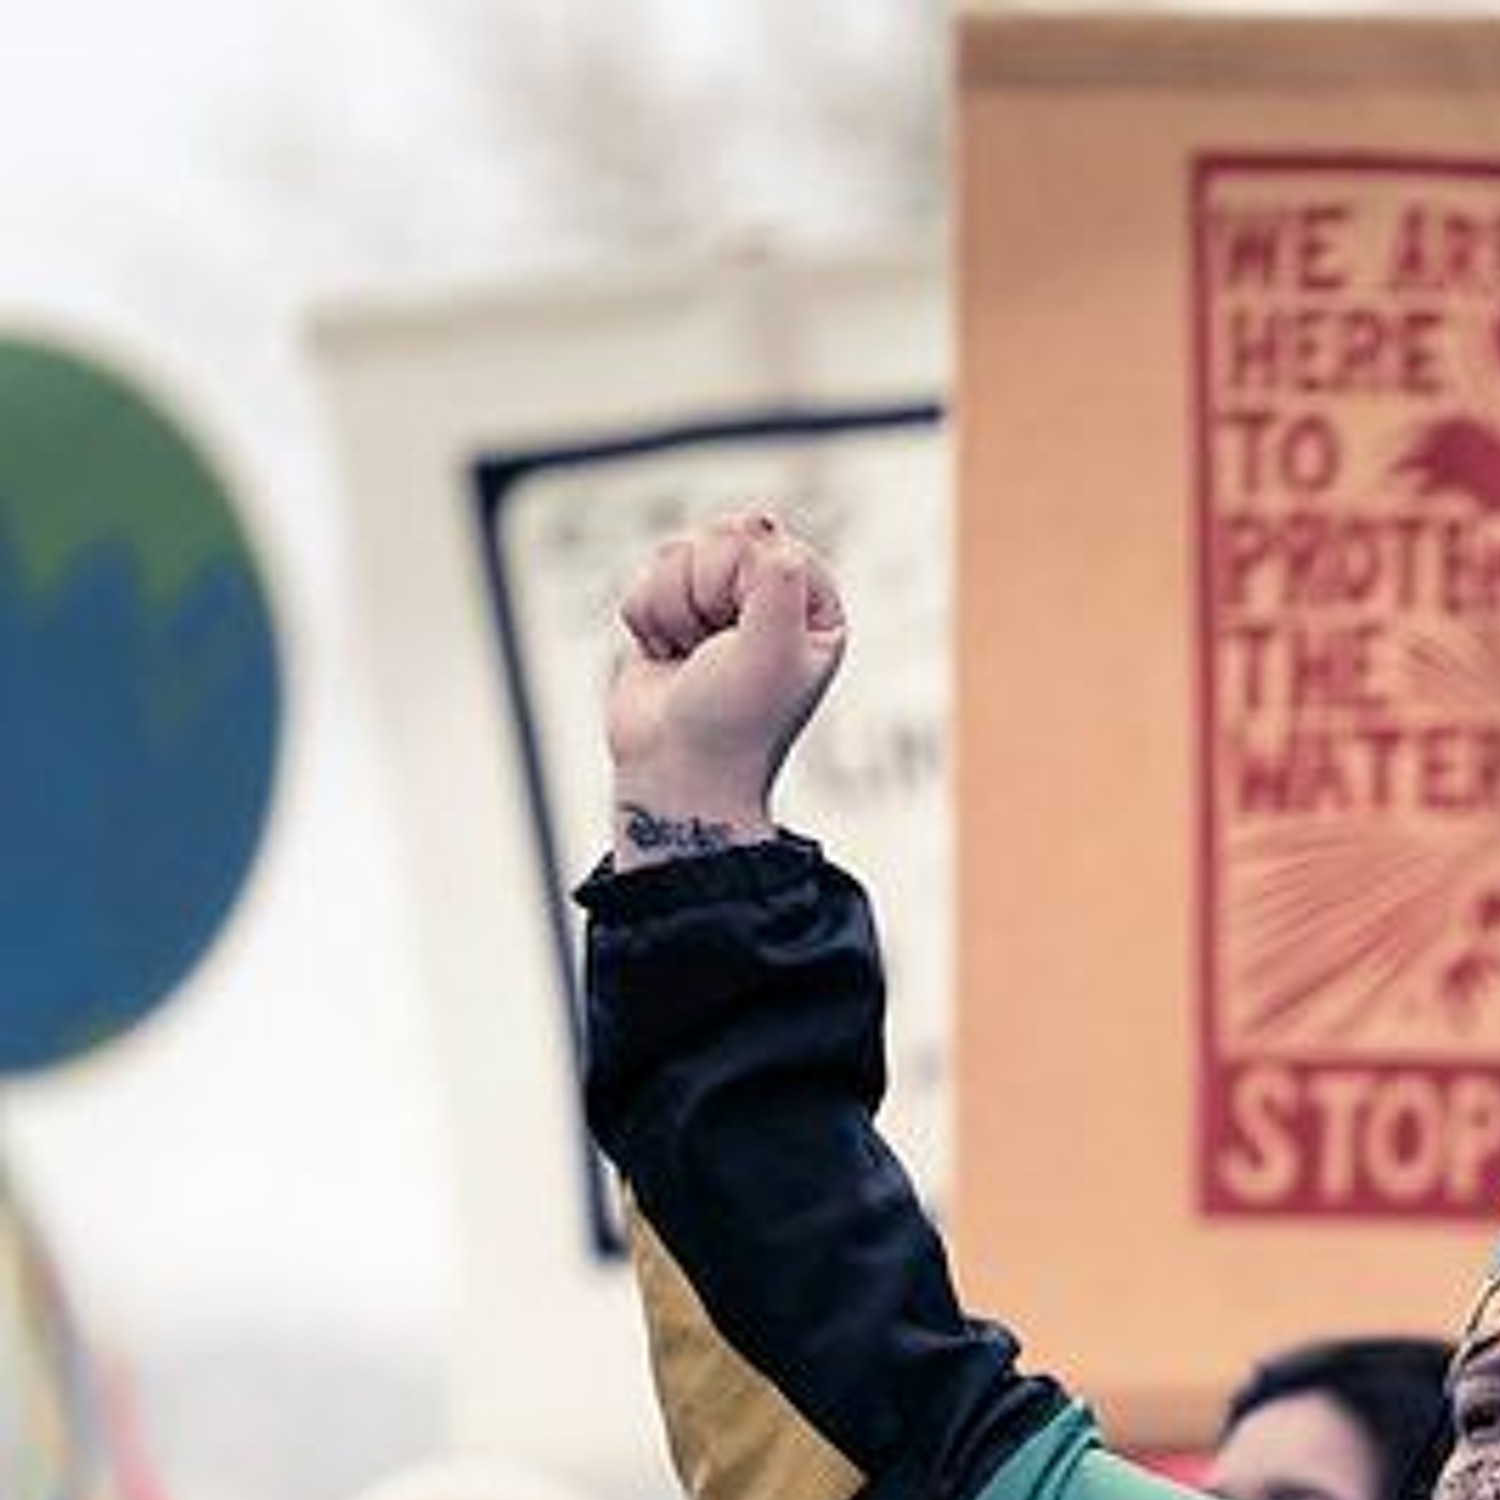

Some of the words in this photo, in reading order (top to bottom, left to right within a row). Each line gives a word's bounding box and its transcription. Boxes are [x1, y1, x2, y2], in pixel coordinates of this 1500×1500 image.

[1224, 204, 1348, 292] WE
[1228, 308, 1442, 394] HERE
[1221, 408, 1340, 495] TO
[1220, 621, 1385, 712] THE
